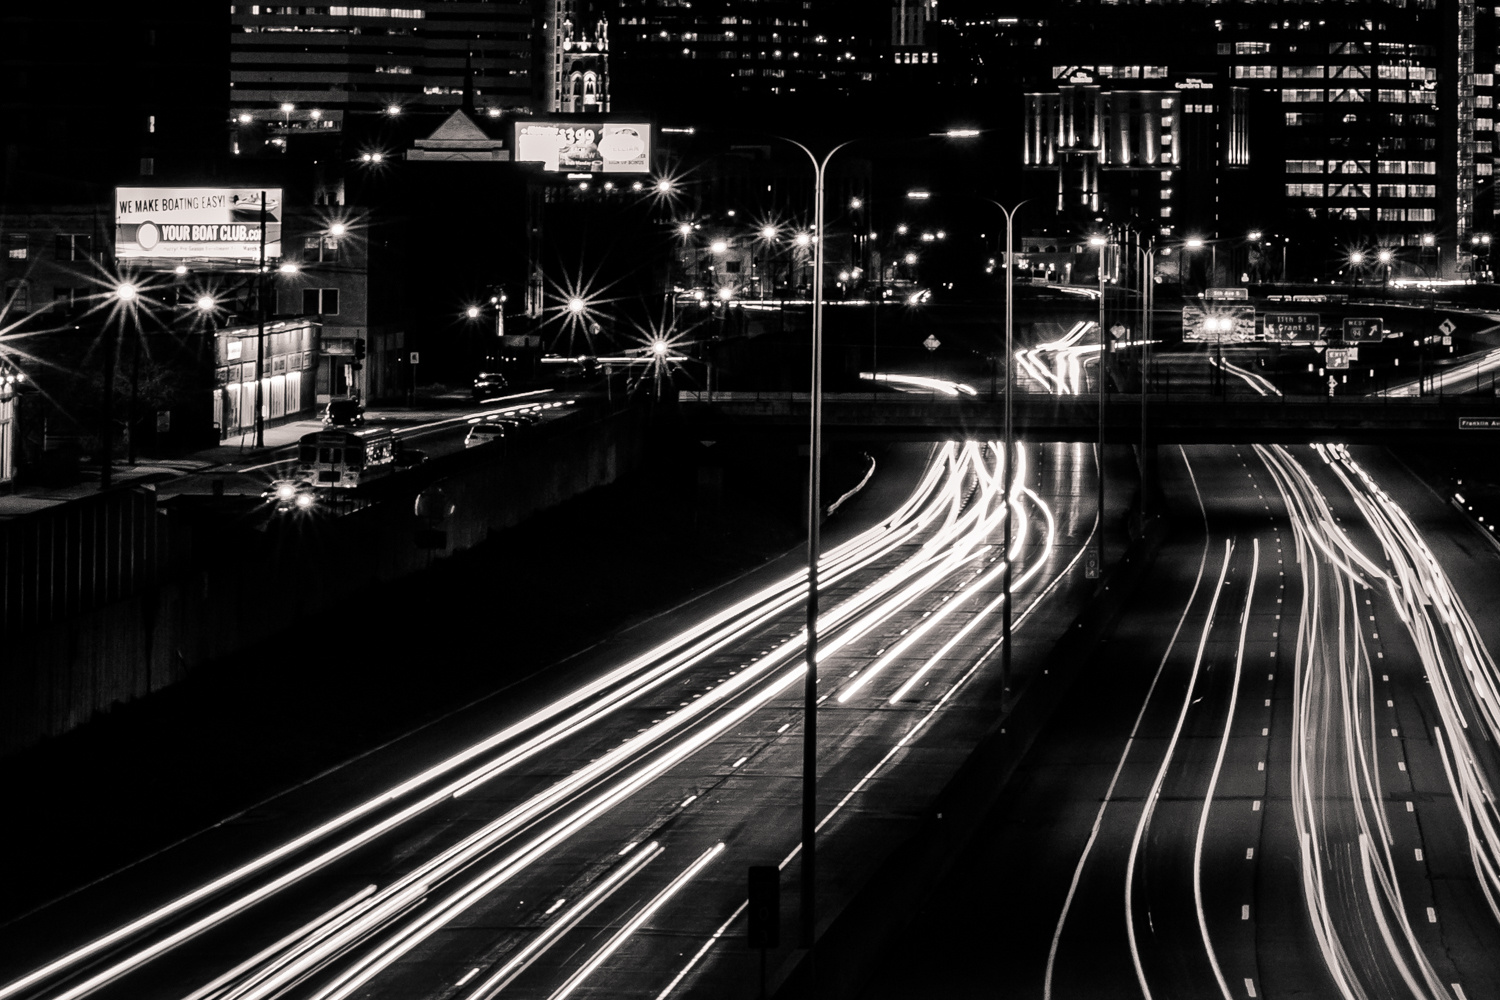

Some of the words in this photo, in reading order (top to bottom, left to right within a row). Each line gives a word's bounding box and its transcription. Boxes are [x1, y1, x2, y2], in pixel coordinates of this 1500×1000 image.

[119, 200, 132, 214] WE
[135, 199, 159, 212] MAKE
[162, 197, 199, 211] BOATING
[202, 195, 226, 209] EASY!
[161, 225, 191, 241] YOUR
[191, 225, 219, 241] BOAT
